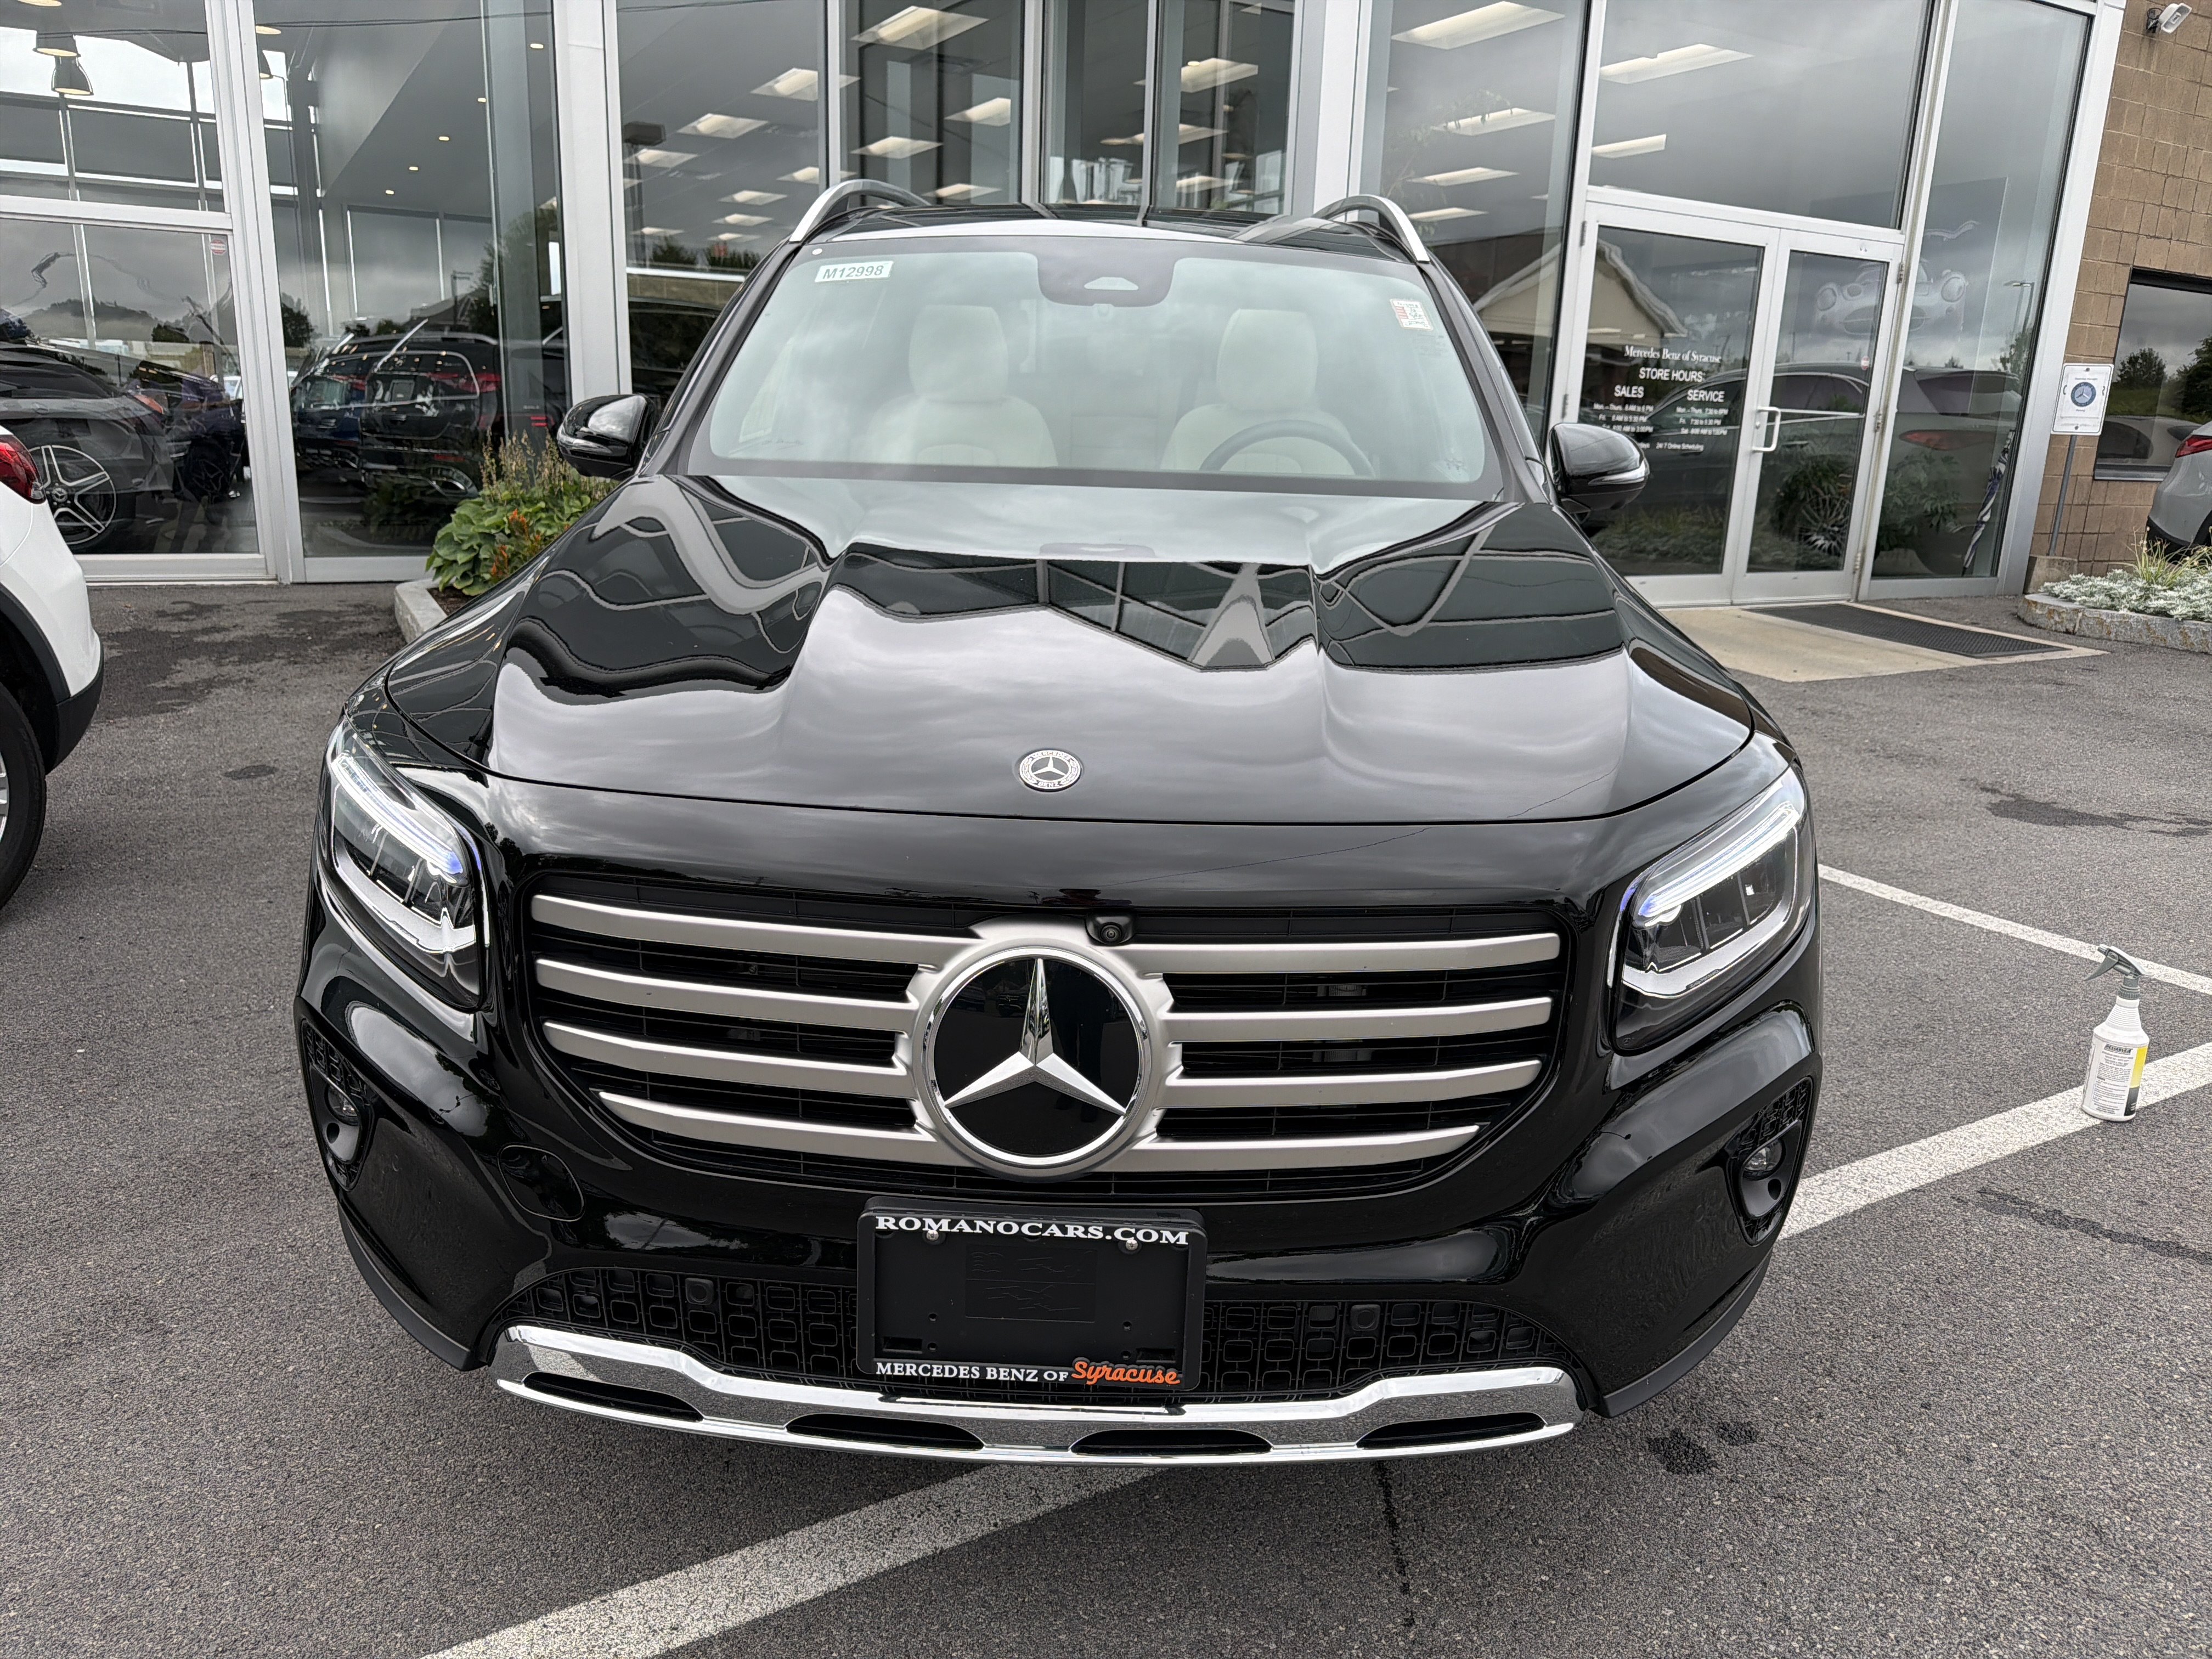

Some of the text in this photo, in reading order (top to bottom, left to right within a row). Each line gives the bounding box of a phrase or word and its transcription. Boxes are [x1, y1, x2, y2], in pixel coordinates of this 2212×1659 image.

[822, 264, 884, 279] M12998
[1624, 345, 1722, 364] Mercedes Benz of Syracuse
[1639, 367, 1706, 383] STORE HOURS:
[1614, 385, 1645, 398] SALES
[1687, 389, 1725, 403] SERVICE
[876, 1216, 1189, 1245] ROMANOCARS.COM
[876, 1362, 1180, 1385] MERCEDES BENZ OF Syracuse
